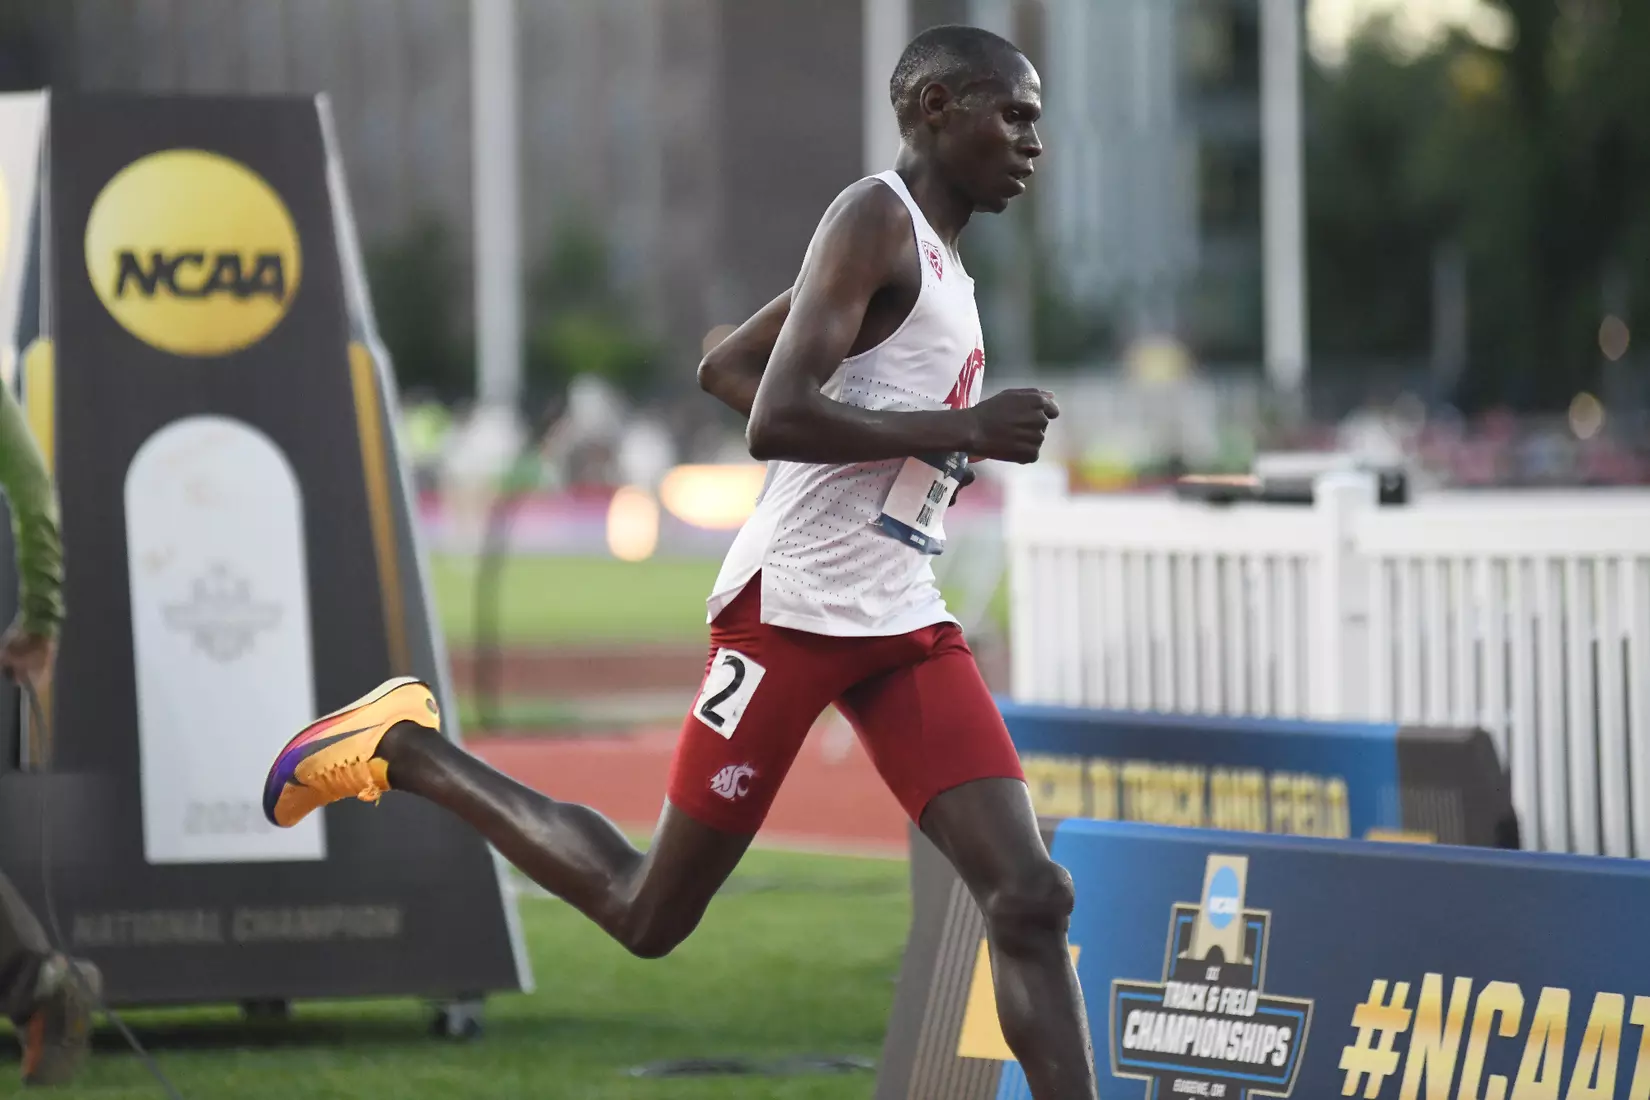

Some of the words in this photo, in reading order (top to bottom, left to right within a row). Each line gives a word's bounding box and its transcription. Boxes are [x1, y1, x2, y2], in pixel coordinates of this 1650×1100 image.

[115, 250, 286, 300] NCAA
[700, 655, 746, 728] 2
[72, 909, 224, 946] NATIONAL
[232, 904, 402, 942] CHAMPION
[1162, 980, 1210, 1012] TRACK
[1205, 985, 1220, 1013] &
[1217, 987, 1259, 1017] FIELD
[1122, 1009, 1292, 1067] CHAMPIONSHIPS
